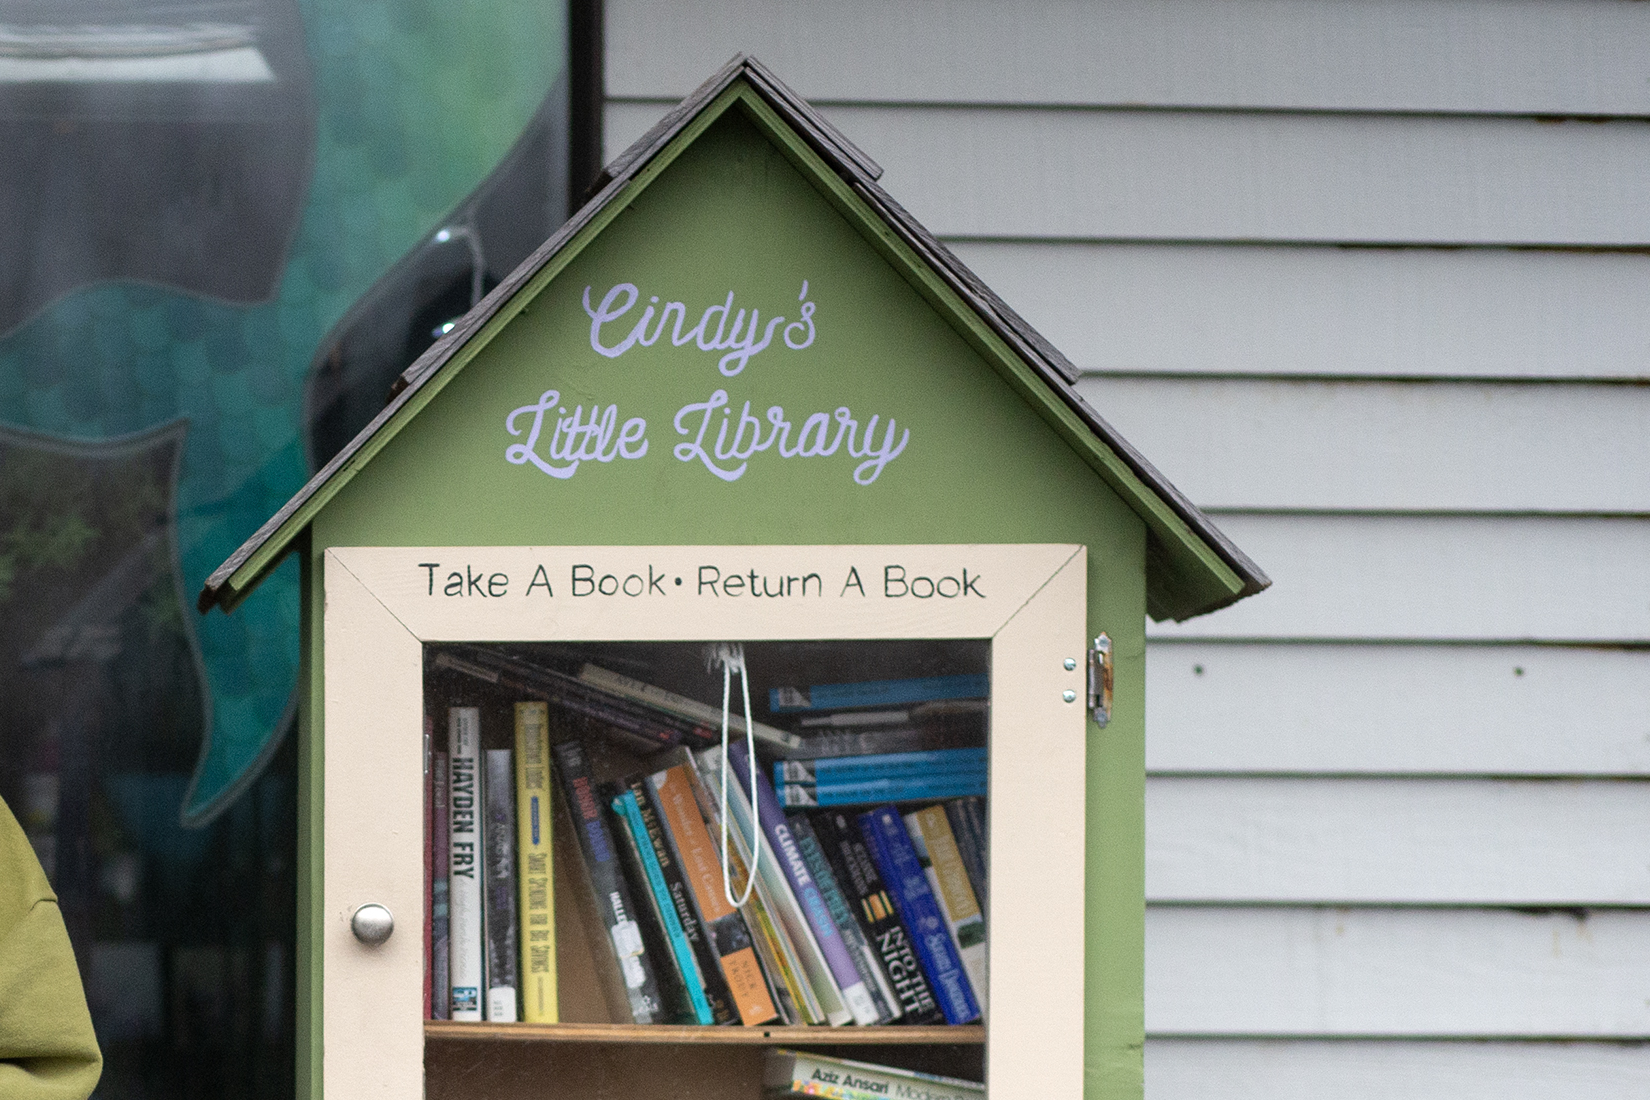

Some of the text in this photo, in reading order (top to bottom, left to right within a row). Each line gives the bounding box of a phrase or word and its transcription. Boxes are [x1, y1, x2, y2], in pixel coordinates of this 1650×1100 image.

[582, 280, 817, 377] Cindy's
[505, 388, 910, 486] Little Library
[418, 562, 509, 598] Take
[526, 563, 554, 598] A
[698, 564, 822, 597] Return
[840, 565, 866, 598] A
[884, 565, 986, 598] Book
[451, 757, 473, 833] HAYDEN
[452, 842, 473, 879] FRY
[771, 822, 812, 887] CLIMATE
[800, 884, 836, 939] CRASH
[667, 880, 702, 943] Saturday
[873, 929, 925, 1019] NIGHT
[888, 924, 918, 972] INTO
[906, 970, 935, 1013] THE
[811, 1068, 839, 1083] Aziz
[842, 1074, 889, 1094] Ansari
